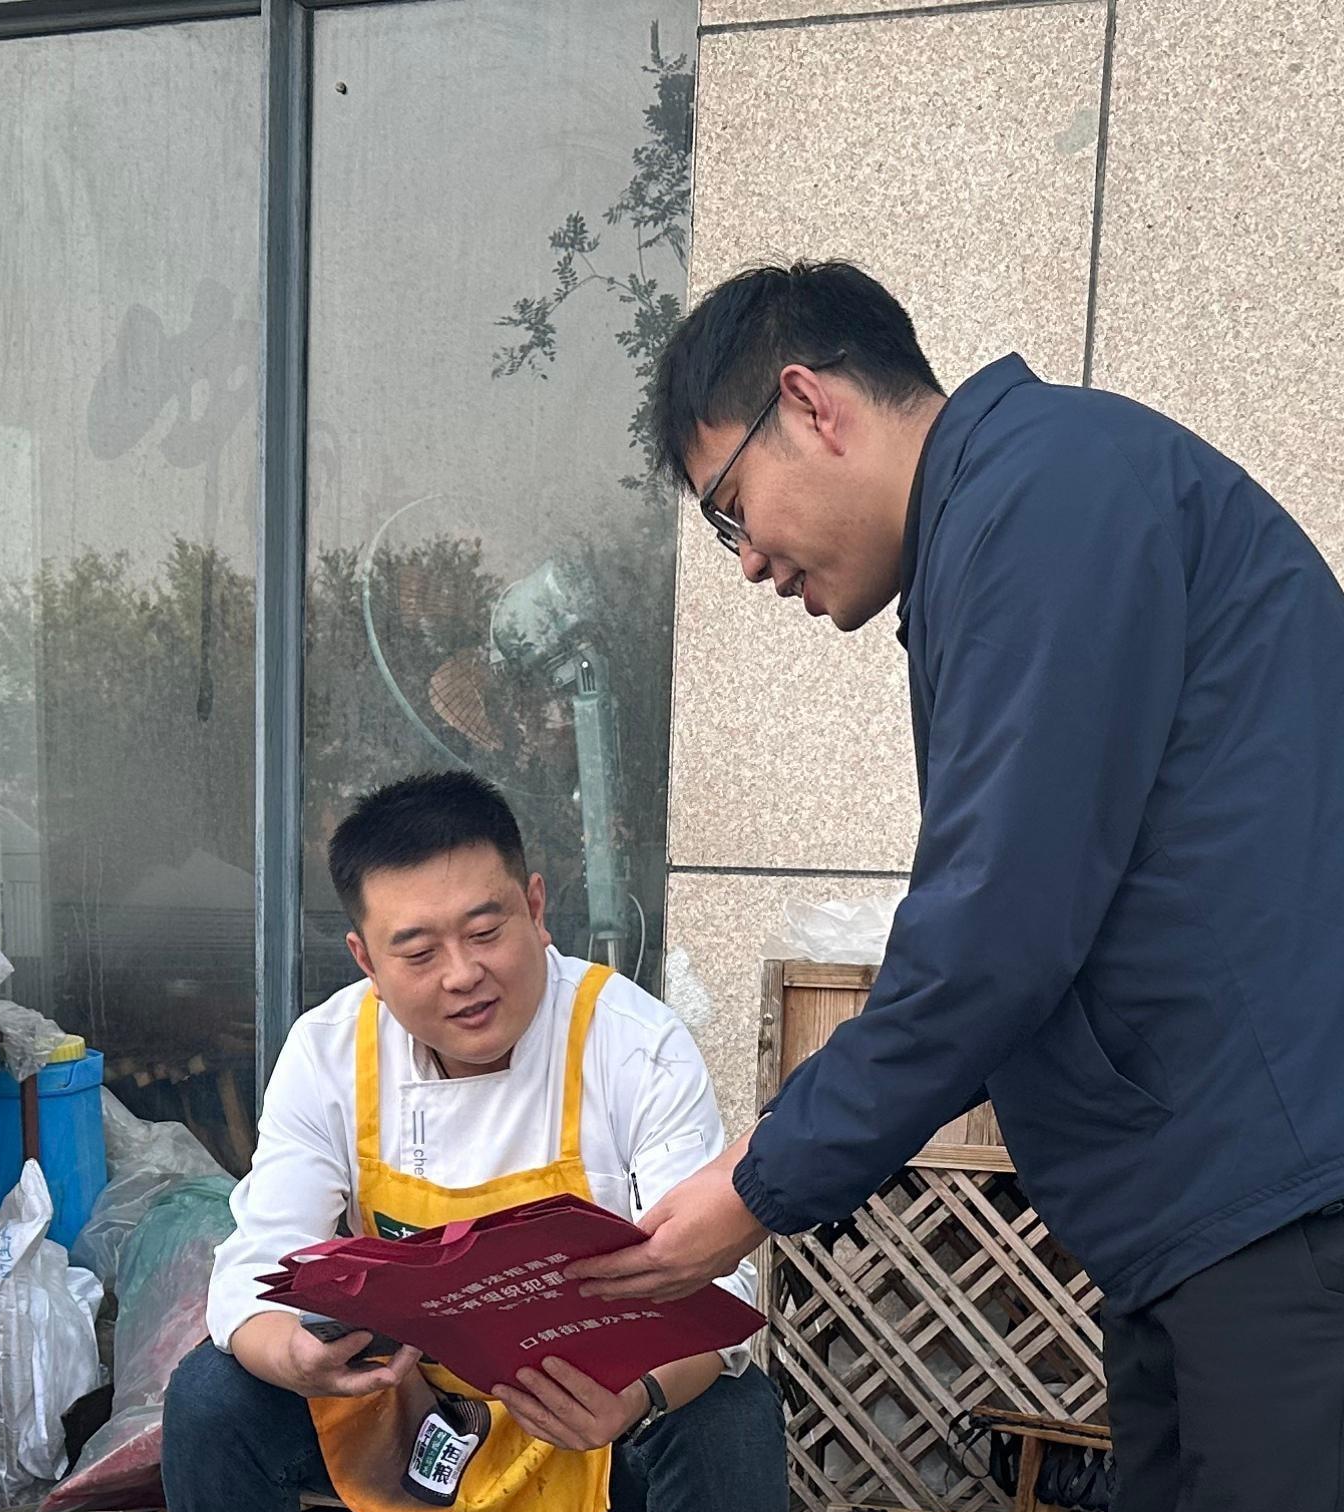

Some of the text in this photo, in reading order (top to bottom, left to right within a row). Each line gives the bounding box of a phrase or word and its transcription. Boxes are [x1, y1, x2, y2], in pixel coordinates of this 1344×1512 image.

[414, 1149, 428, 1180] che
[432, 1436, 470, 1485] 一担粮
